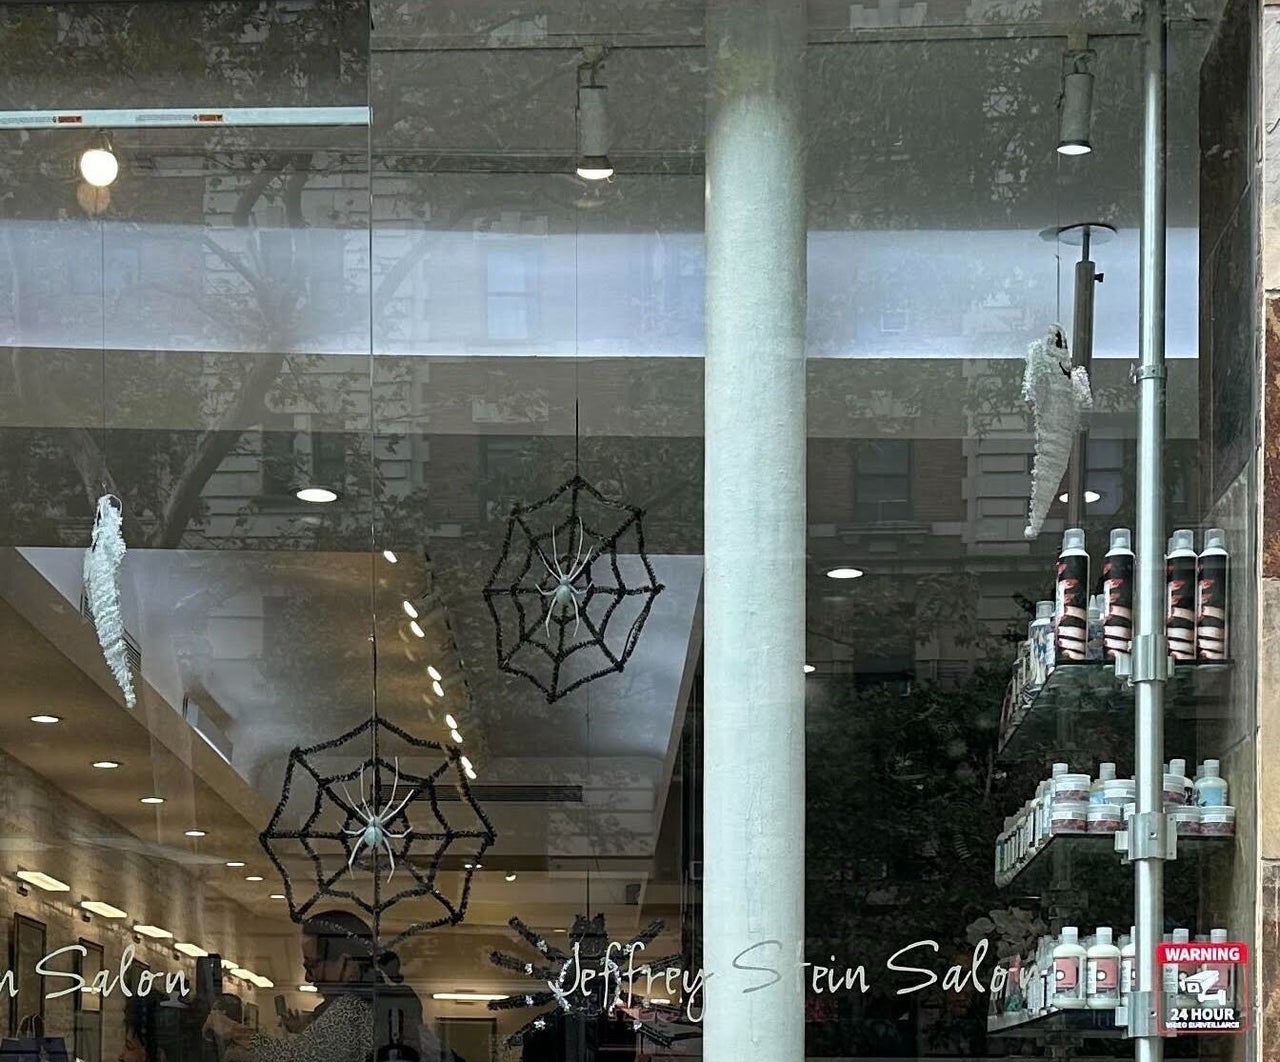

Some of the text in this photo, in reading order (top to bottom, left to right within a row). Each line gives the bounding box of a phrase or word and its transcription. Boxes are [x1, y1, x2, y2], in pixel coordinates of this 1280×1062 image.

[35, 943, 191, 999] Salon
[1165, 947, 1240, 961] WARNING
[547, 939, 1042, 1023] Jeffrey Stein Salon
[1170, 1007, 1235, 1021] 24 HOUR
